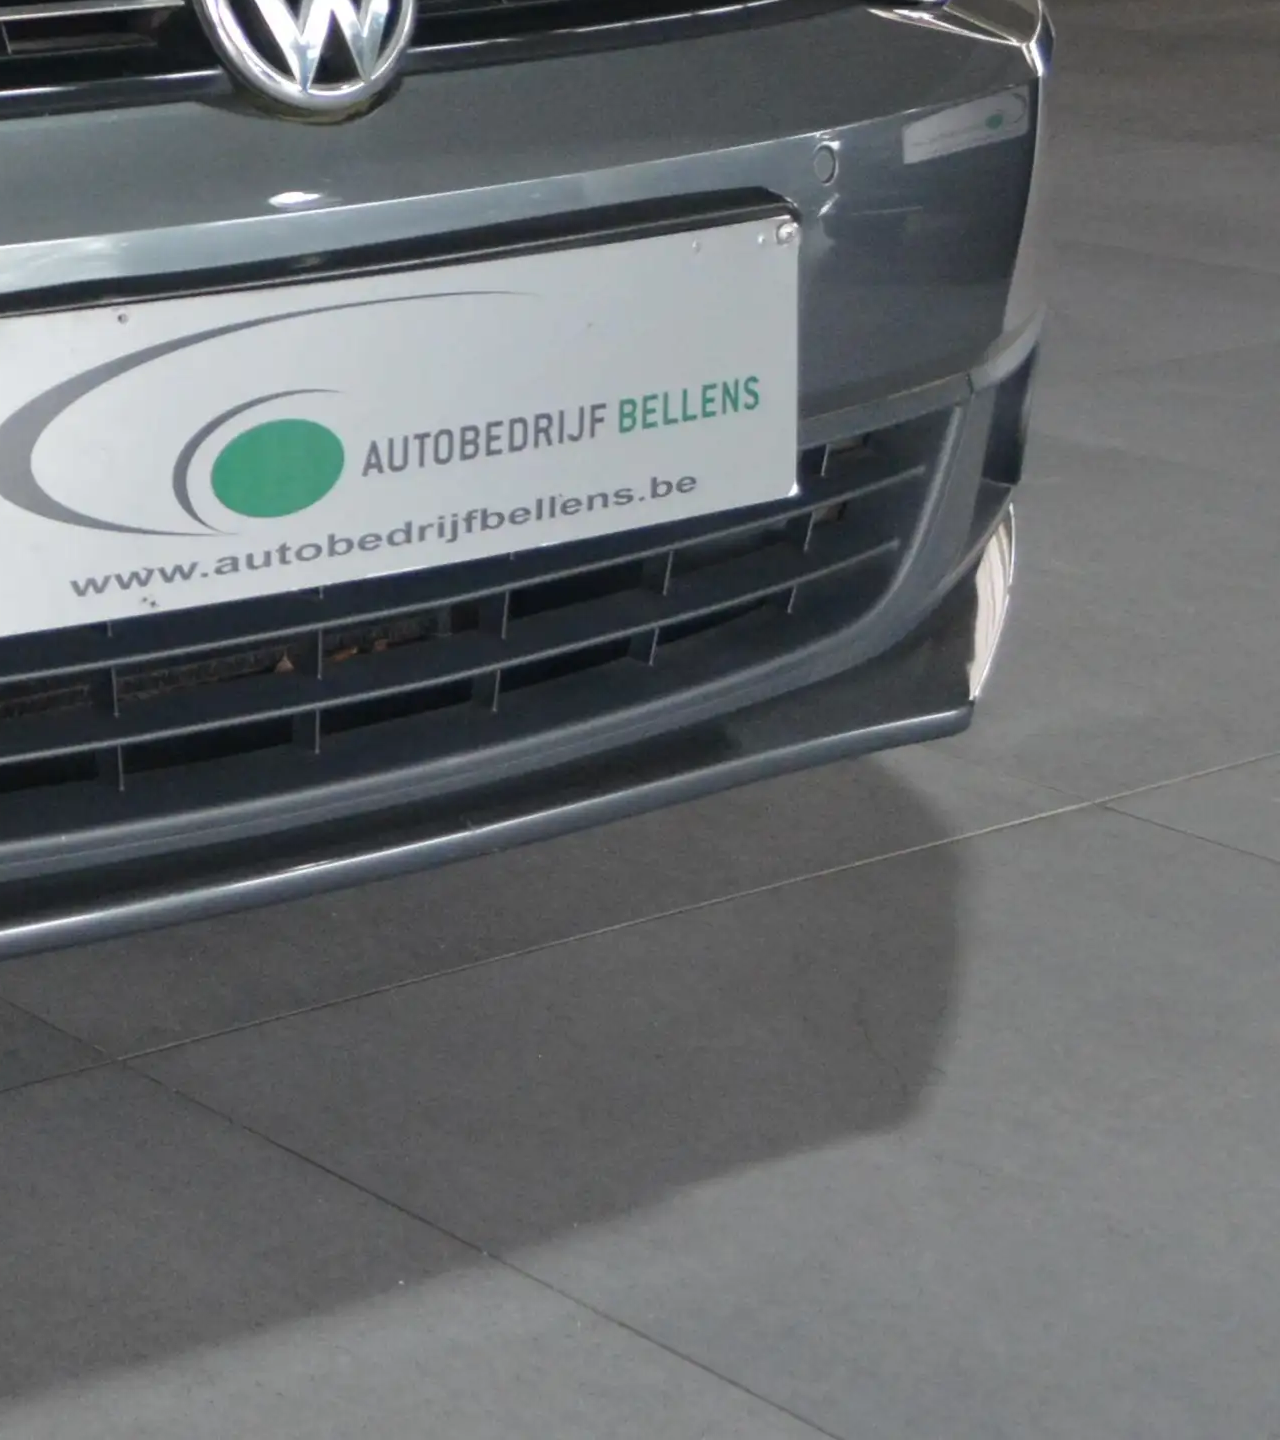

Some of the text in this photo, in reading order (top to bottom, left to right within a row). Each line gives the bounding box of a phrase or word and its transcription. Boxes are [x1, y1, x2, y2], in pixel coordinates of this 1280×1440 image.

[362, 375, 761, 477] AUTOBEDRIJF BELLENS
[68, 471, 699, 599] www.autobedrijfbellens.be
